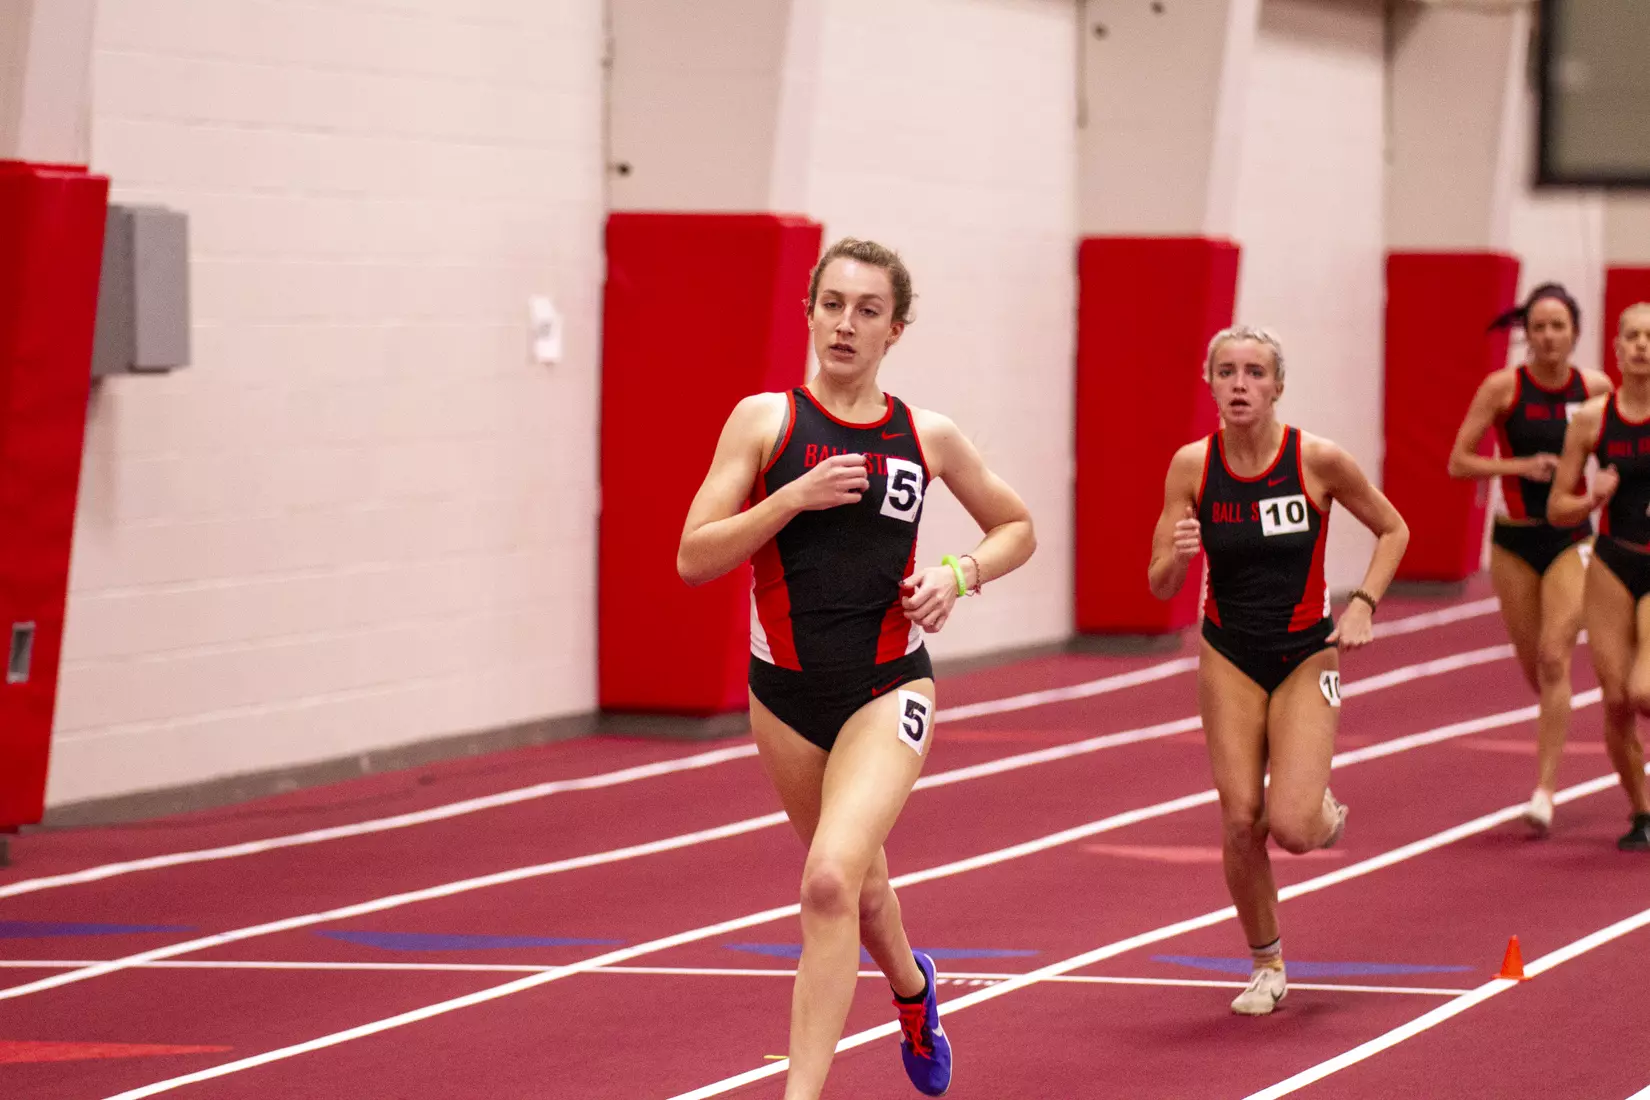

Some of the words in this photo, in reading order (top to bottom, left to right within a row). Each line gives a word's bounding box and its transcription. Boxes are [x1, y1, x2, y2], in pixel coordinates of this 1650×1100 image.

[888, 468, 918, 512] 5
[1212, 501, 1244, 523] BALL
[1265, 500, 1305, 527] 10
[902, 698, 927, 742] 5
